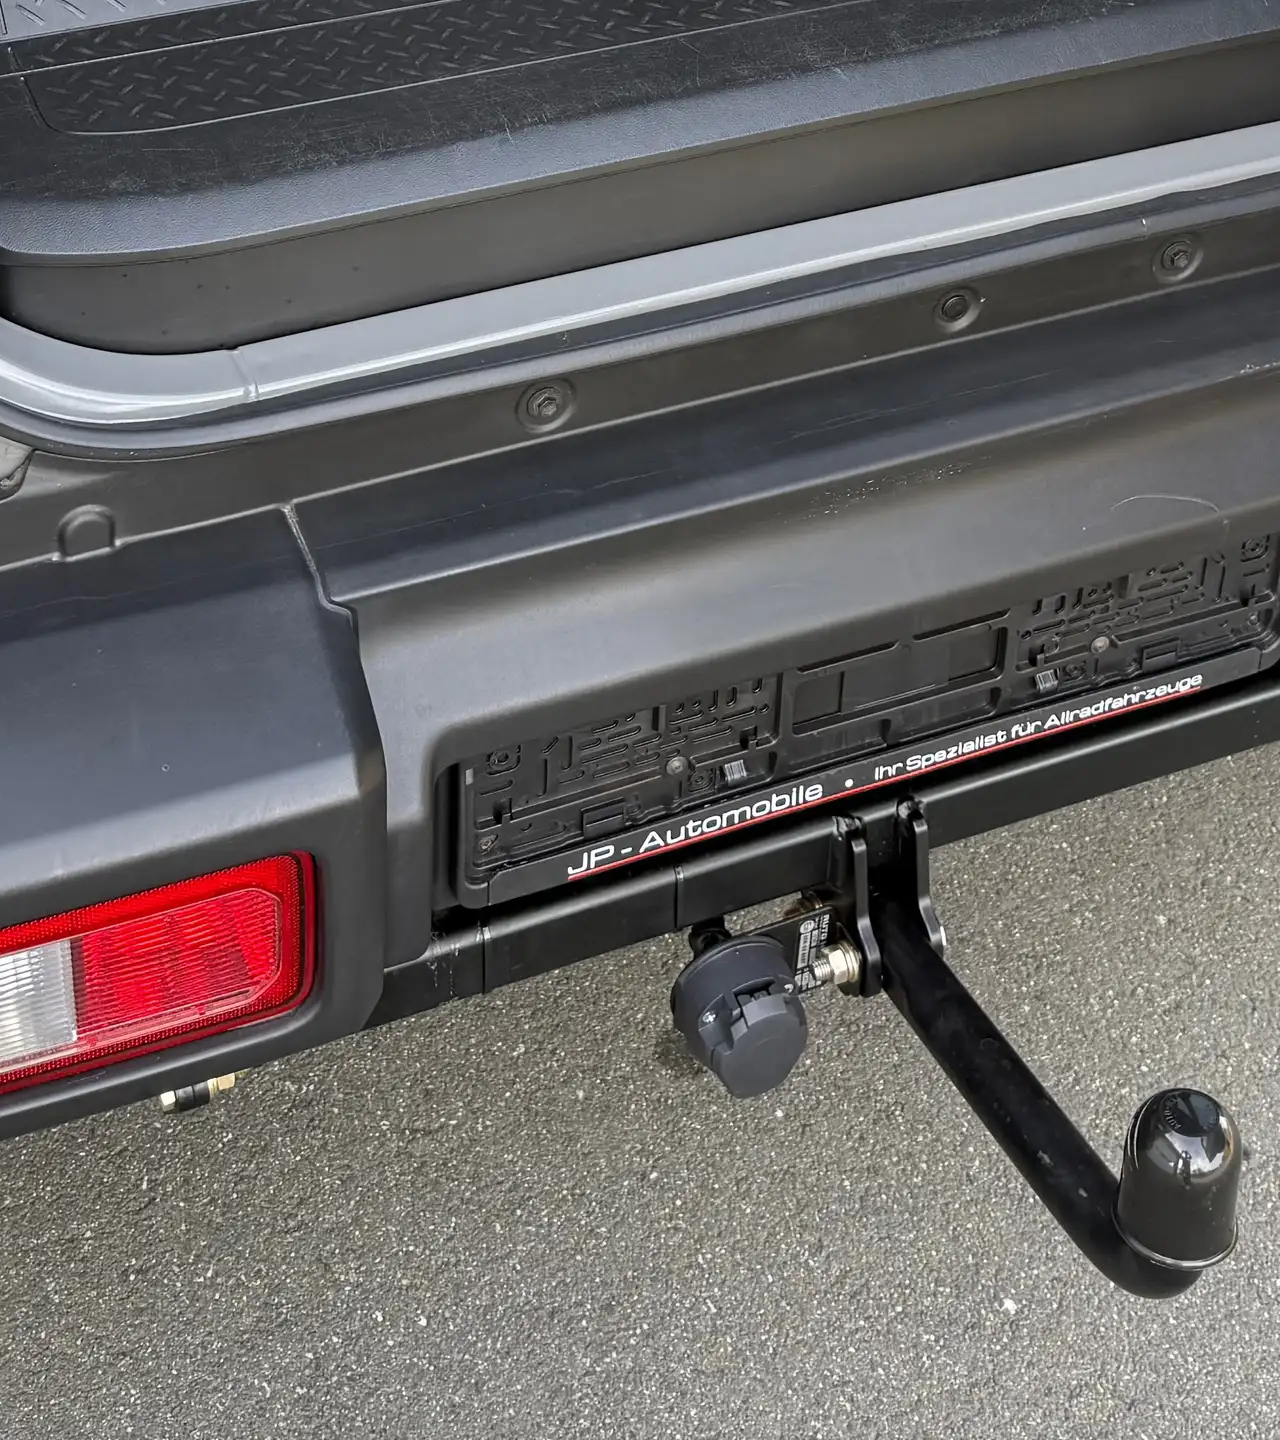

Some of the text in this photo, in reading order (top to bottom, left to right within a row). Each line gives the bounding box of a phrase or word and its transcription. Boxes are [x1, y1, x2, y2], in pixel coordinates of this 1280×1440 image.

[567, 845, 615, 874] JP
[639, 782, 823, 854] Automobile
[875, 761, 907, 782] Ihr
[906, 729, 1008, 772] Spezialist
[1011, 720, 1043, 739] für
[1043, 674, 1203, 730] Allradfahrzeuge
